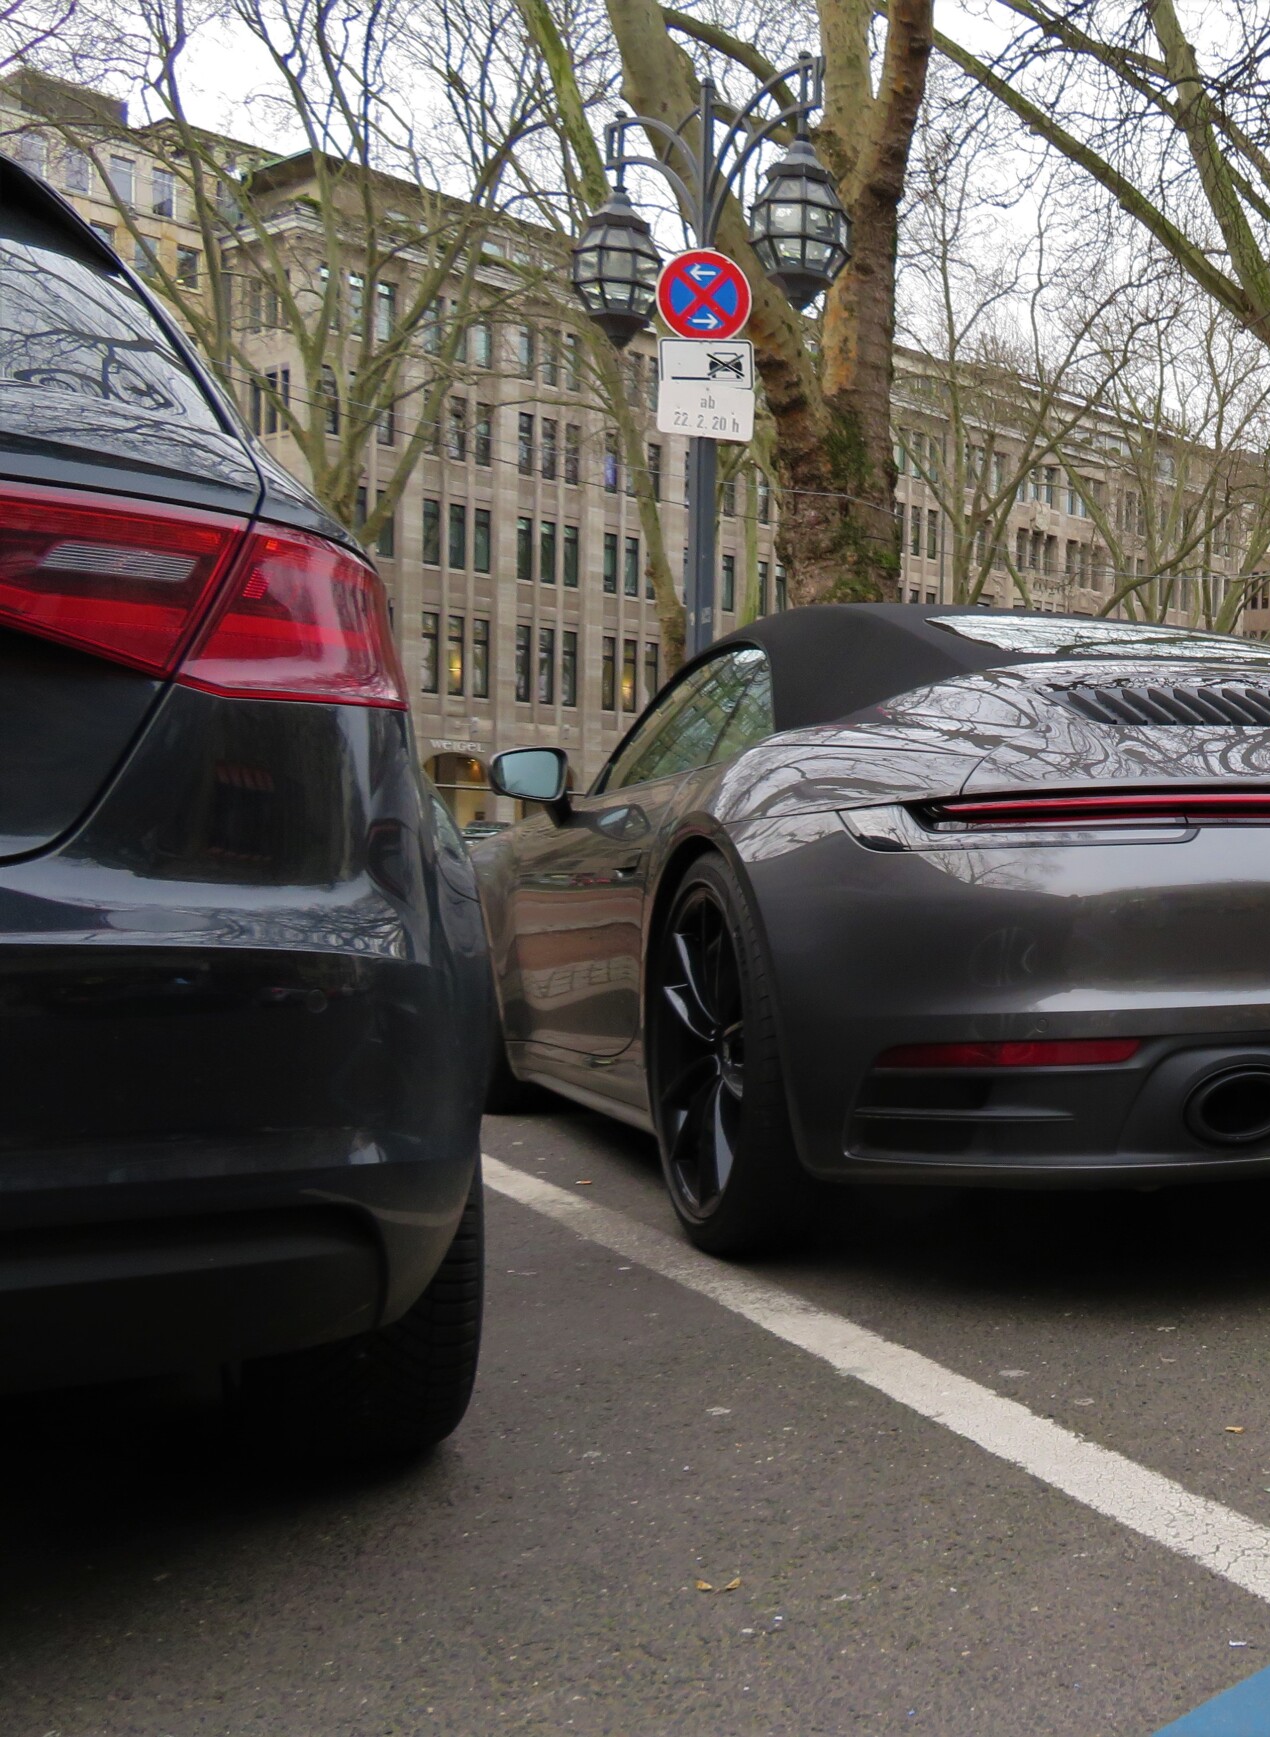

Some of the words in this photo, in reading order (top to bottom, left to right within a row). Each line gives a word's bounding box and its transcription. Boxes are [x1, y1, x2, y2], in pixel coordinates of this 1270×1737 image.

[700, 395, 715, 409] ab
[673, 411, 692, 427] 22.
[712, 416, 727, 431] 20
[732, 417, 739, 433] h
